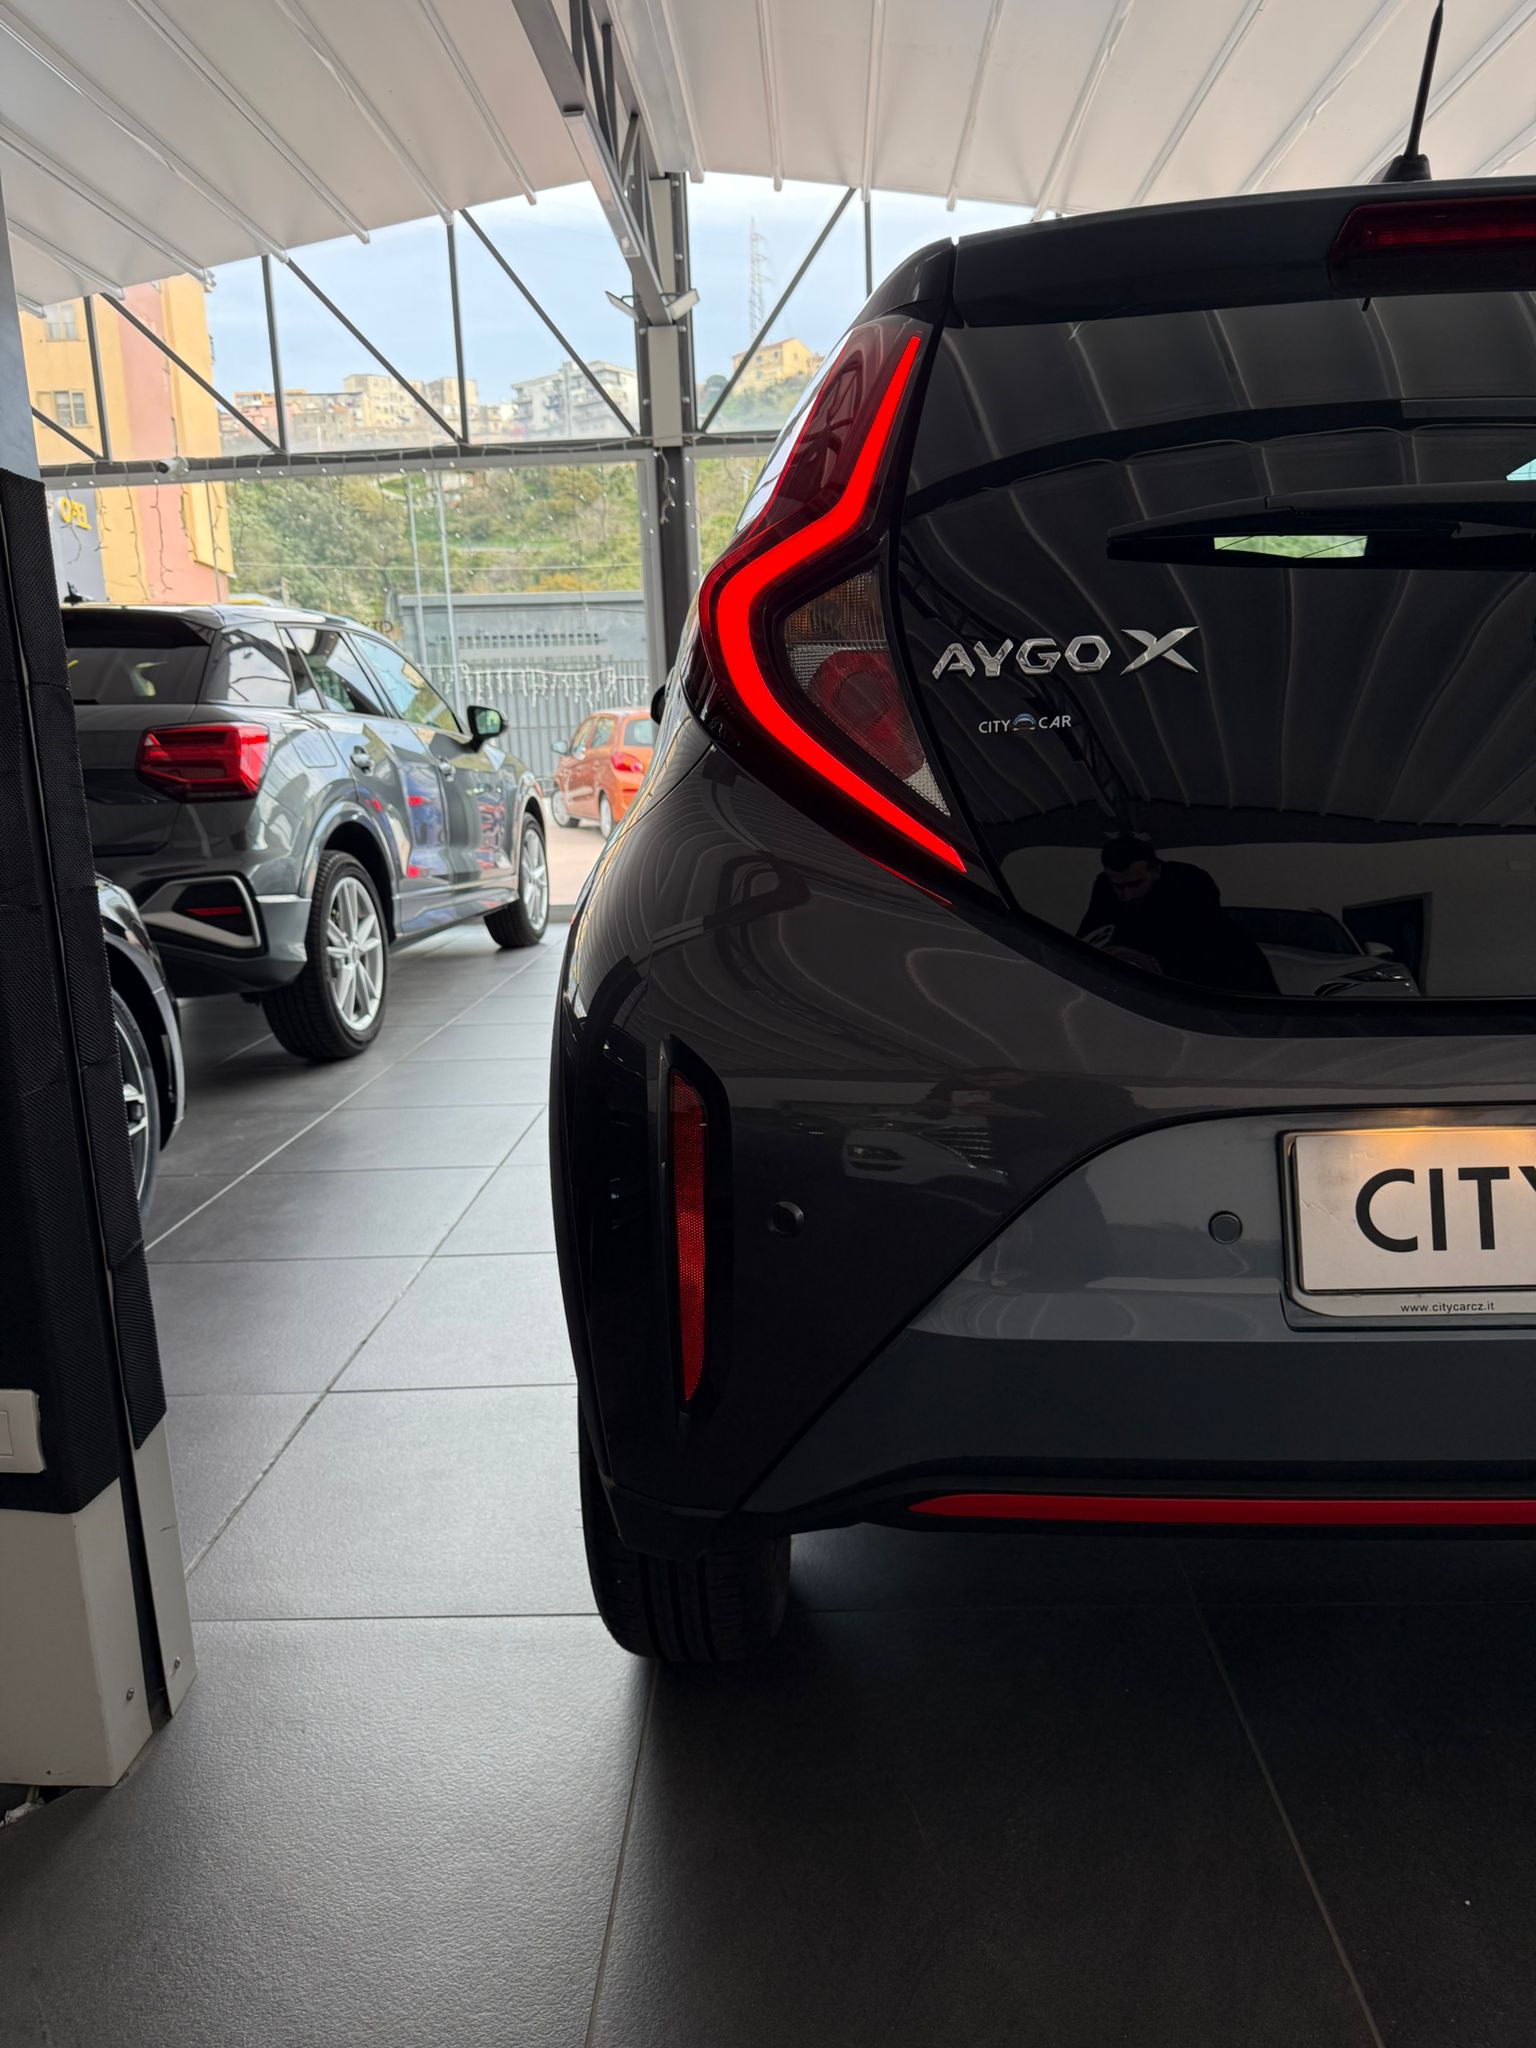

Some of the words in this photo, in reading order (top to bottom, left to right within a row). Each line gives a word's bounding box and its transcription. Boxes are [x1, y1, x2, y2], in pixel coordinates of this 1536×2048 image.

[932, 635, 1112, 680] AYGO
[1121, 626, 1200, 675] X
[978, 719, 1011, 734] CITY
[1038, 715, 1072, 729] CAR
[1355, 1166, 1536, 1253] CIT
[1400, 1301, 1495, 1314] www.citycarcz.it
